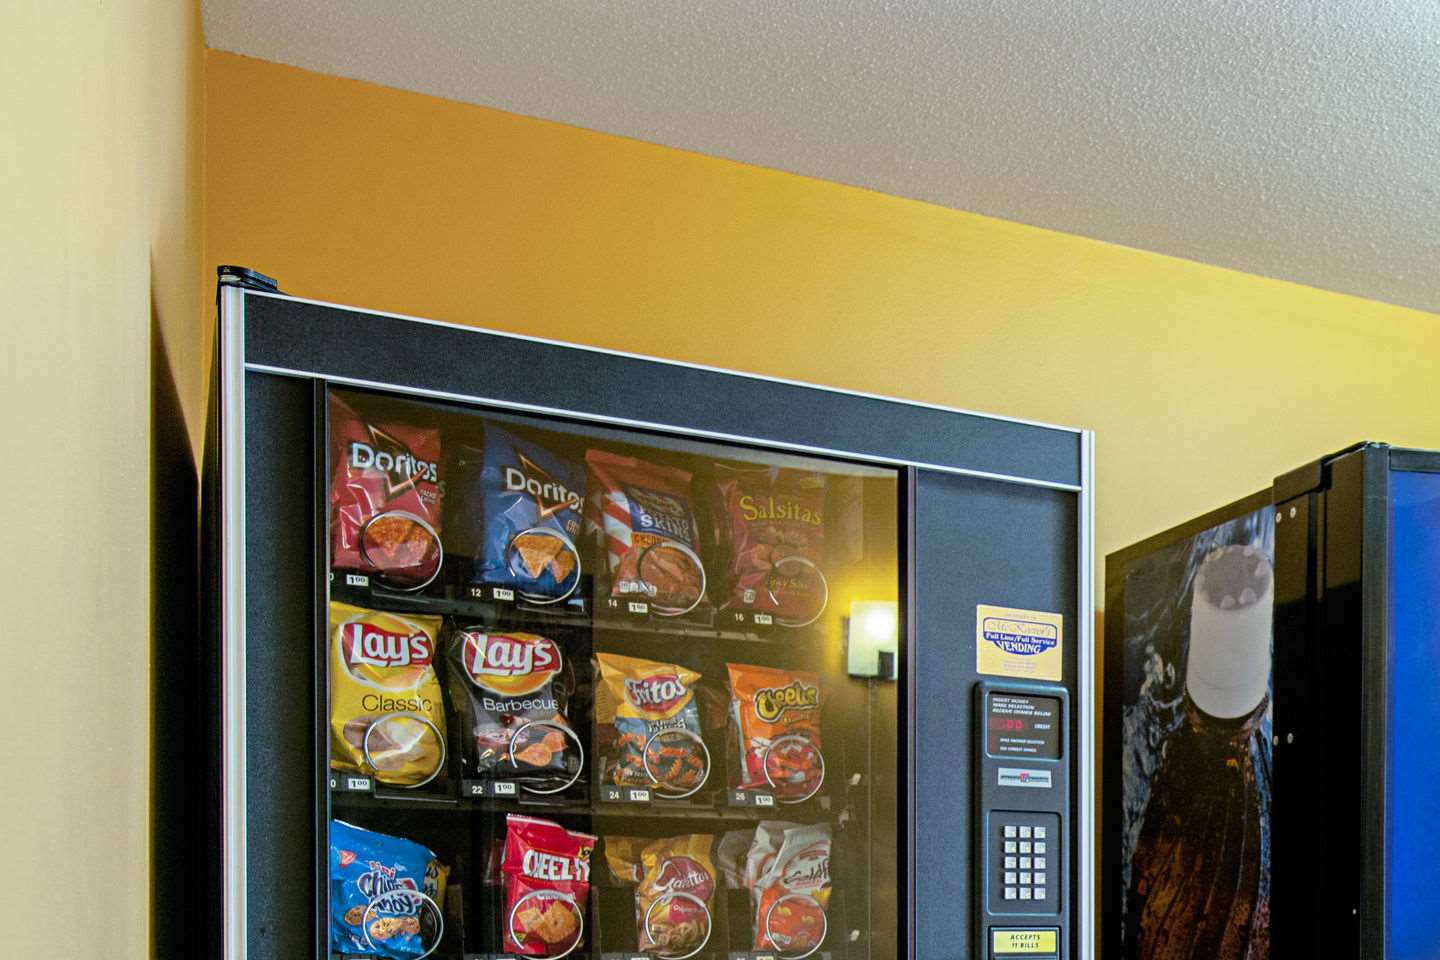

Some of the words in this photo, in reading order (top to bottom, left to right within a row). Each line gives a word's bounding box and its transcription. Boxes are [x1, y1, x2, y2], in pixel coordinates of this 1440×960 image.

[351, 442, 438, 483] Doritos
[739, 495, 823, 526] Salsitas
[471, 588, 481, 597] 12
[608, 599, 618, 608] 14
[351, 623, 430, 667] Lay's
[994, 640, 1042, 654] VENDING
[1031, 637, 1055, 645] Service
[472, 635, 553, 675] Lay's
[361, 694, 433, 712] Classic
[472, 785, 483, 795] 22
[609, 791, 620, 800] 24
